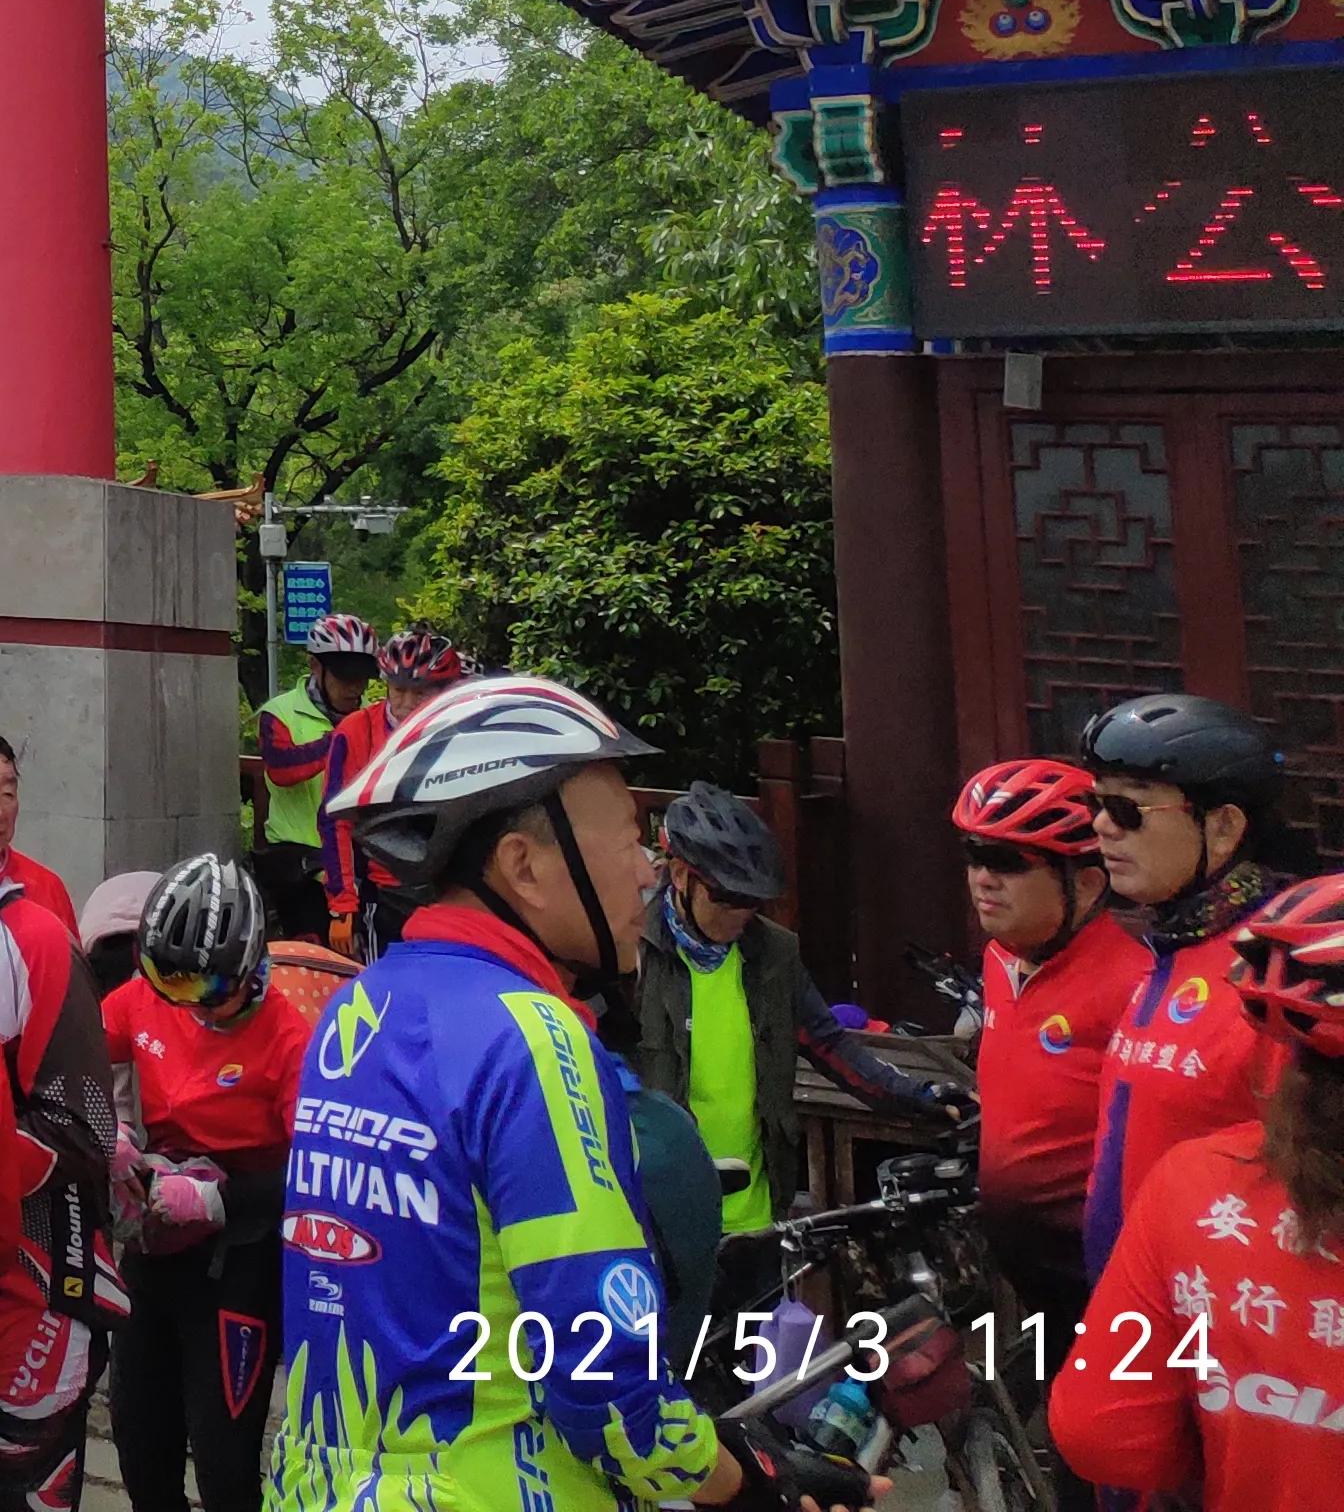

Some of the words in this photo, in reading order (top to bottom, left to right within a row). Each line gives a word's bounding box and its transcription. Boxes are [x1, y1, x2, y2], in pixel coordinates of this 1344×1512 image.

[424, 756, 518, 789] MERIDA
[134, 1031, 166, 1060] 安徽
[531, 1000, 614, 1192] MERIDA
